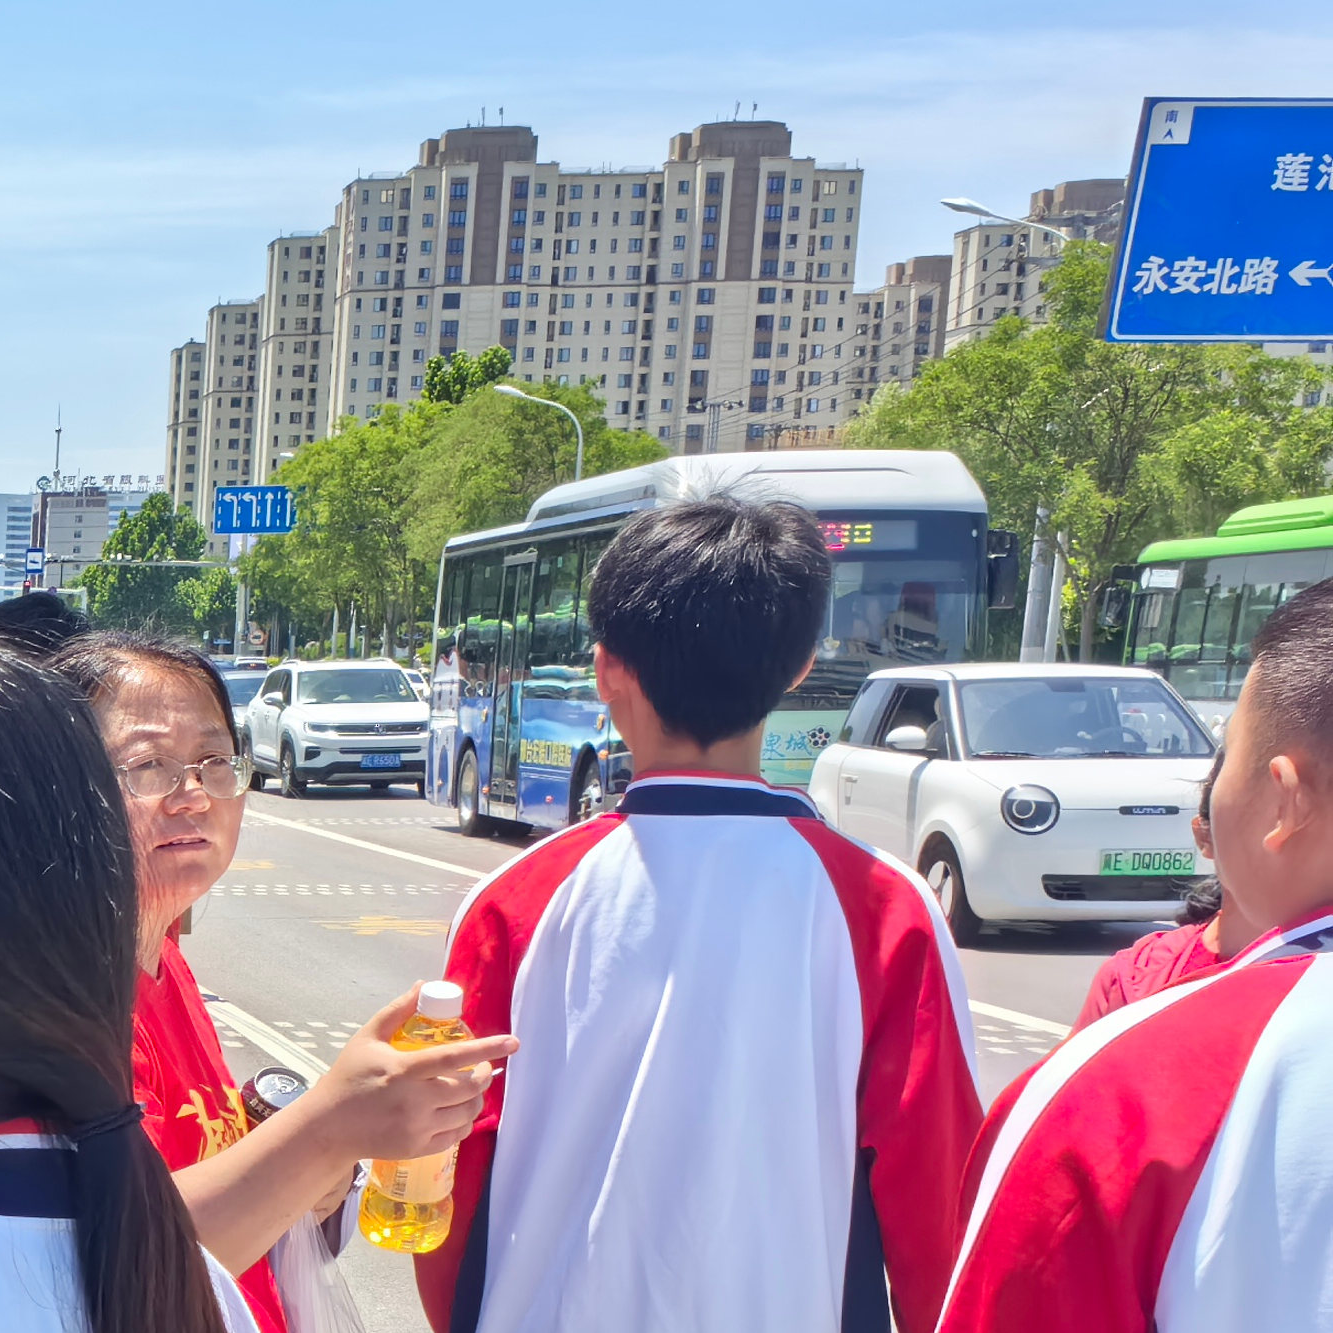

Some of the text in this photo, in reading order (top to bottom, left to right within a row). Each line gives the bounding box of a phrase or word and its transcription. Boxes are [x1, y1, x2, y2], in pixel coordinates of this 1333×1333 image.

[1165, 110, 1179, 123] 南
[1132, 256, 1279, 295] 永安北路
